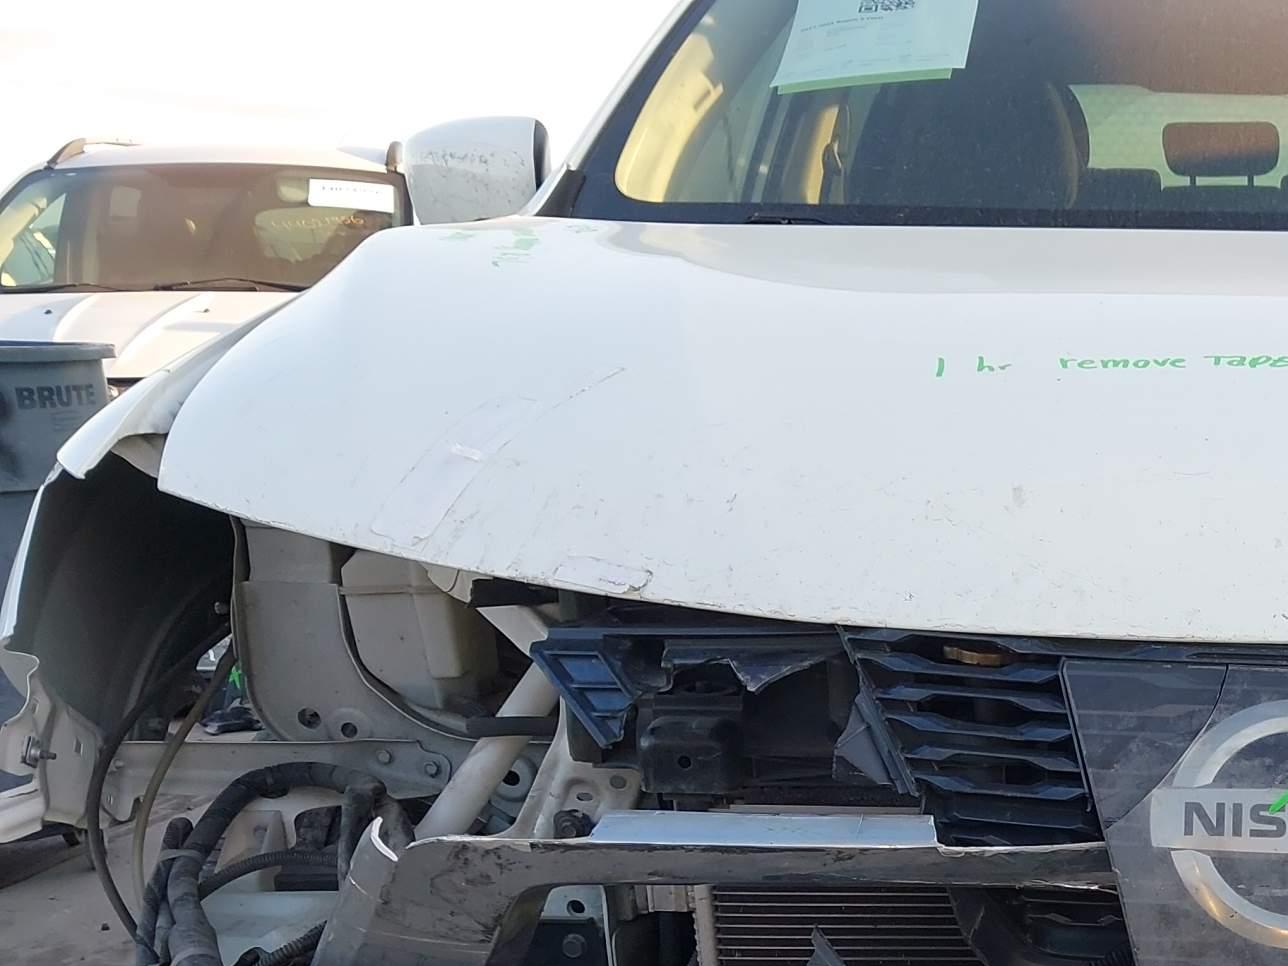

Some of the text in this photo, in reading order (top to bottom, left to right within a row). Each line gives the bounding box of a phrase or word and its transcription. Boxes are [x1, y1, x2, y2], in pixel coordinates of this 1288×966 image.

[976, 356, 1012, 372] hr
[1058, 355, 1186, 369] remove
[15, 384, 96, 409] BRUTE
